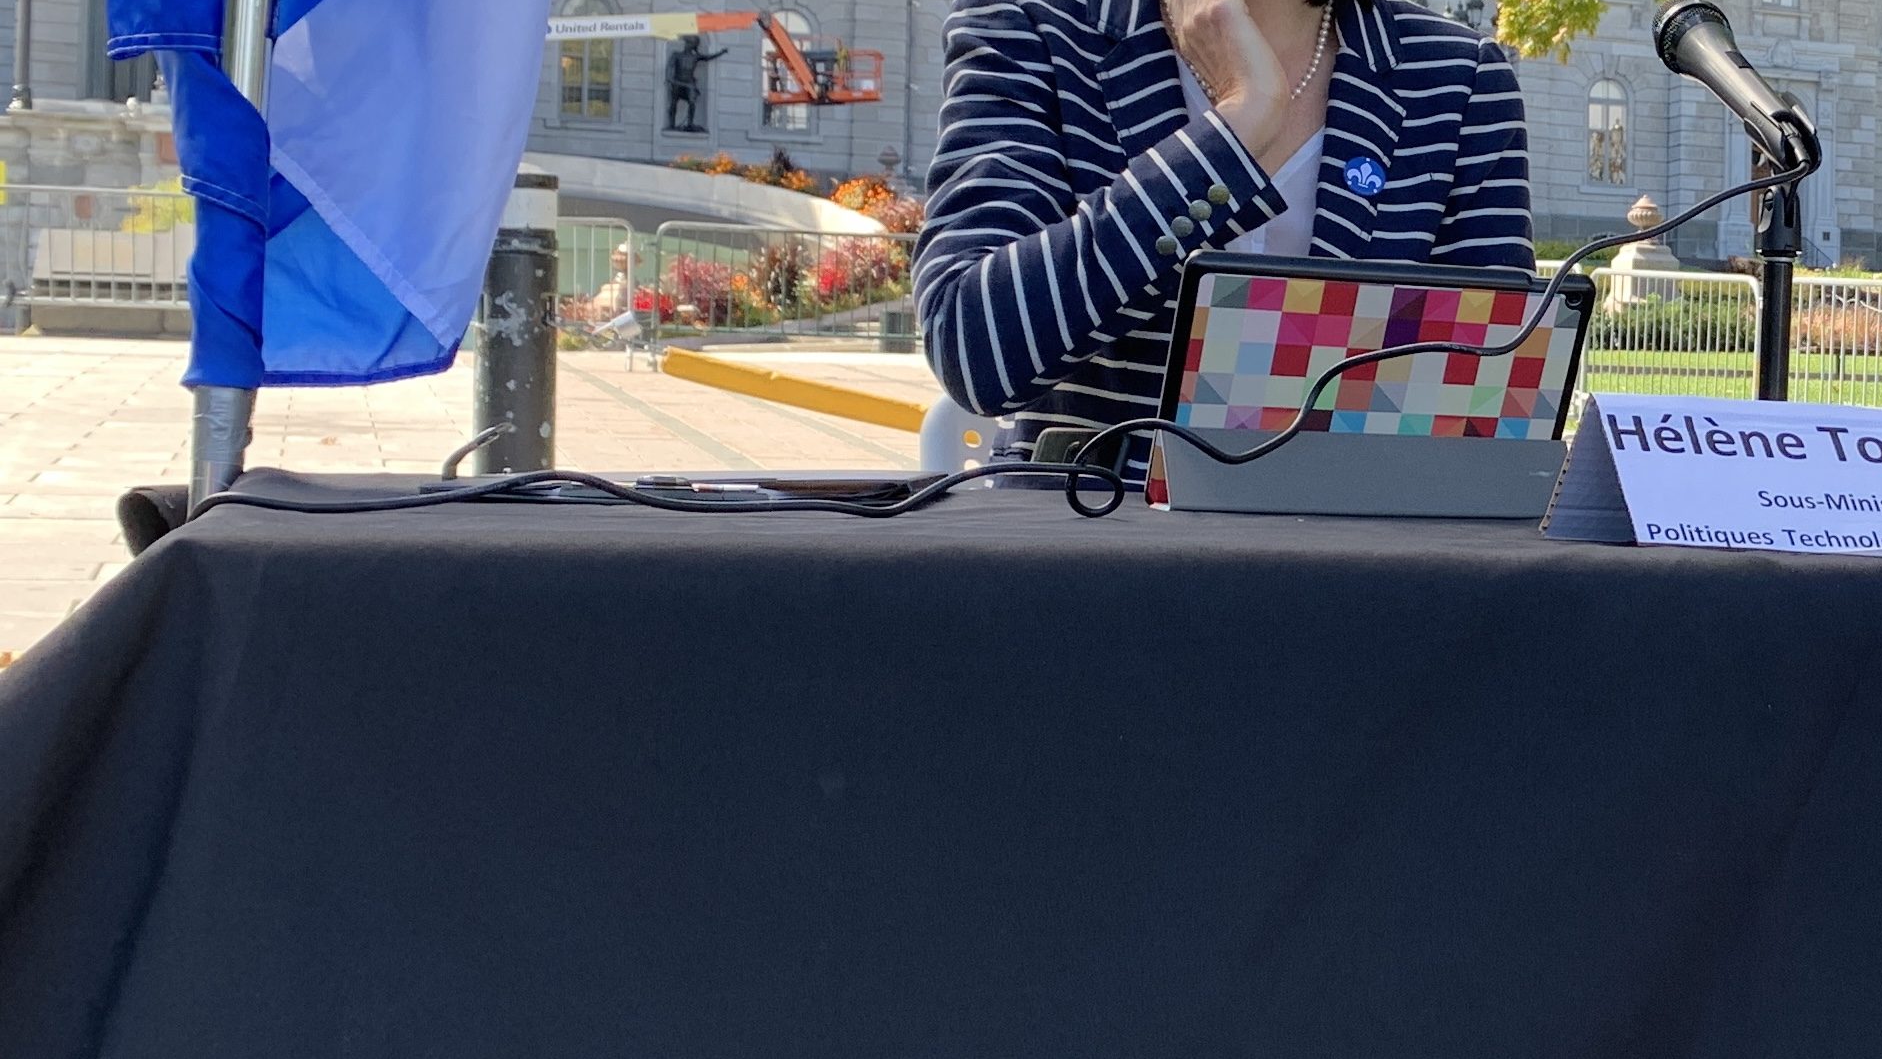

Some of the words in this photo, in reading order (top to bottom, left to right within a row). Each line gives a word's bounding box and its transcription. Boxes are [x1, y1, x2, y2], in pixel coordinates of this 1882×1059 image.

[556, 22, 597, 34] United
[600, 20, 645, 32] Rentals
[1606, 414, 1807, 459] Hélène
[1646, 523, 1775, 548] Politiques
